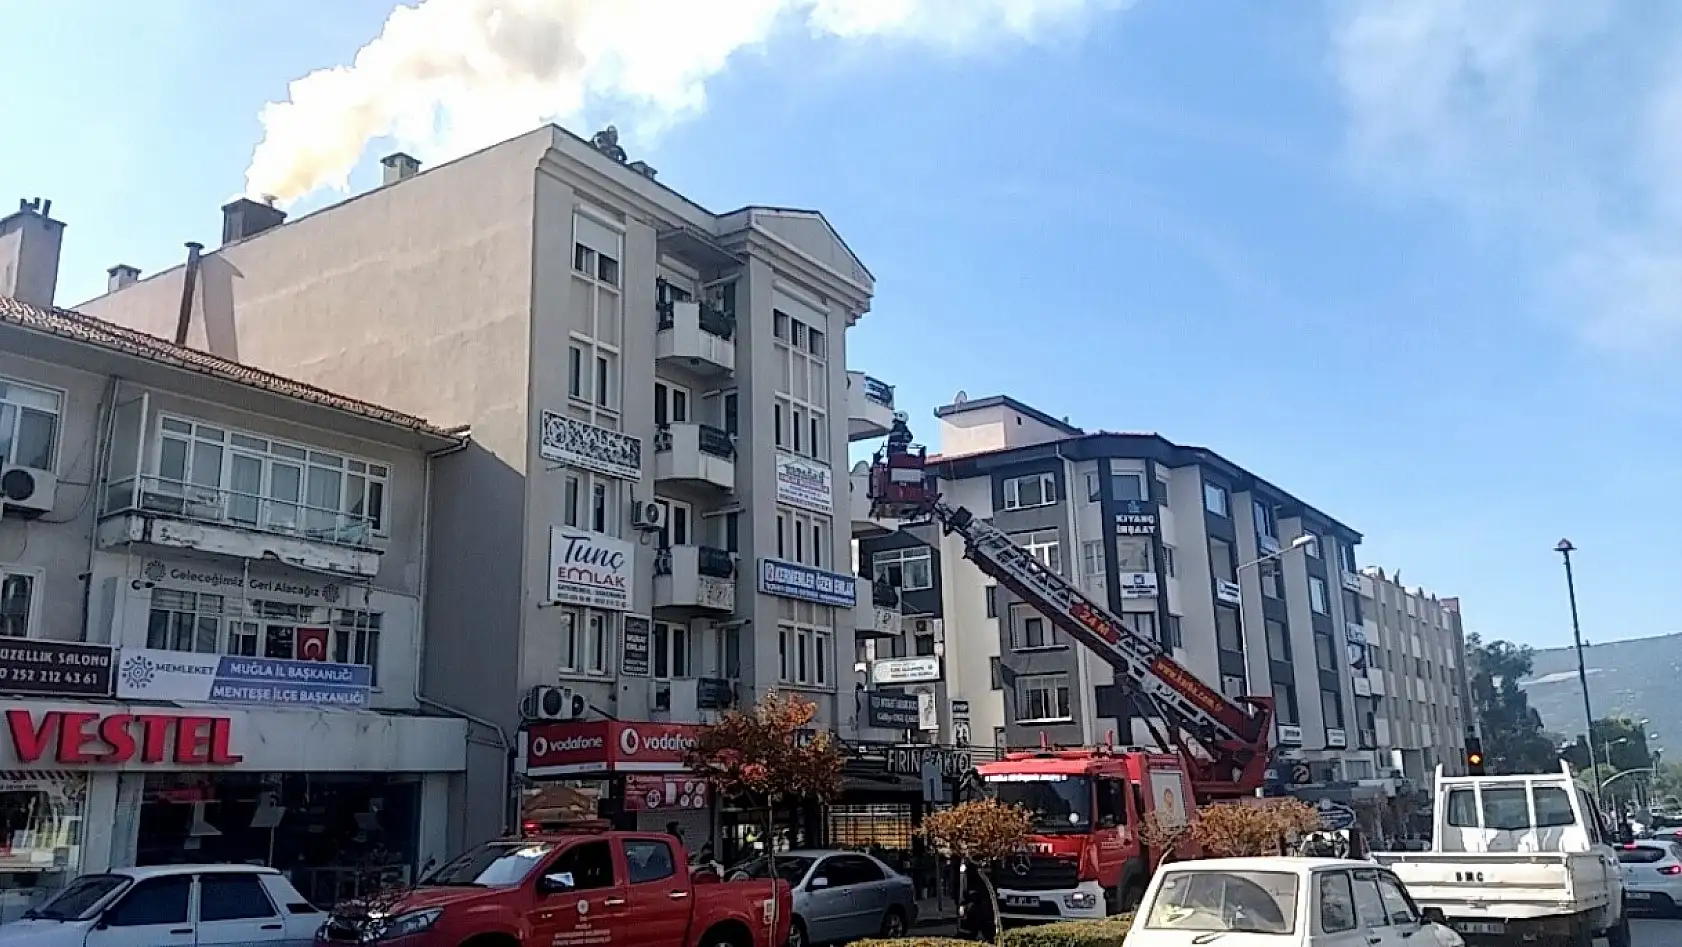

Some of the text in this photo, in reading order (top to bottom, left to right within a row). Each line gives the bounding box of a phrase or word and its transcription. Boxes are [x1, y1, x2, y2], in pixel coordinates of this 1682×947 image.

[561, 533, 626, 573] Tunç
[170, 568, 320, 598] Geleceğimiz Geri Alacağız
[557, 566, 626, 588] EMLAK
[58, 652, 109, 667] SALONU
[155, 662, 214, 676] MEMLEKET
[230, 661, 273, 677] MUĞLA
[288, 666, 352, 683] BAŞKANLIĞI
[213, 684, 364, 706] MENTEŞE İLÇE BAŞKANLIĞI
[5, 709, 243, 764] VESTEL
[550, 735, 603, 751] vodafone
[643, 732, 700, 751] vodafon
[888, 749, 921, 773] FIRIN
